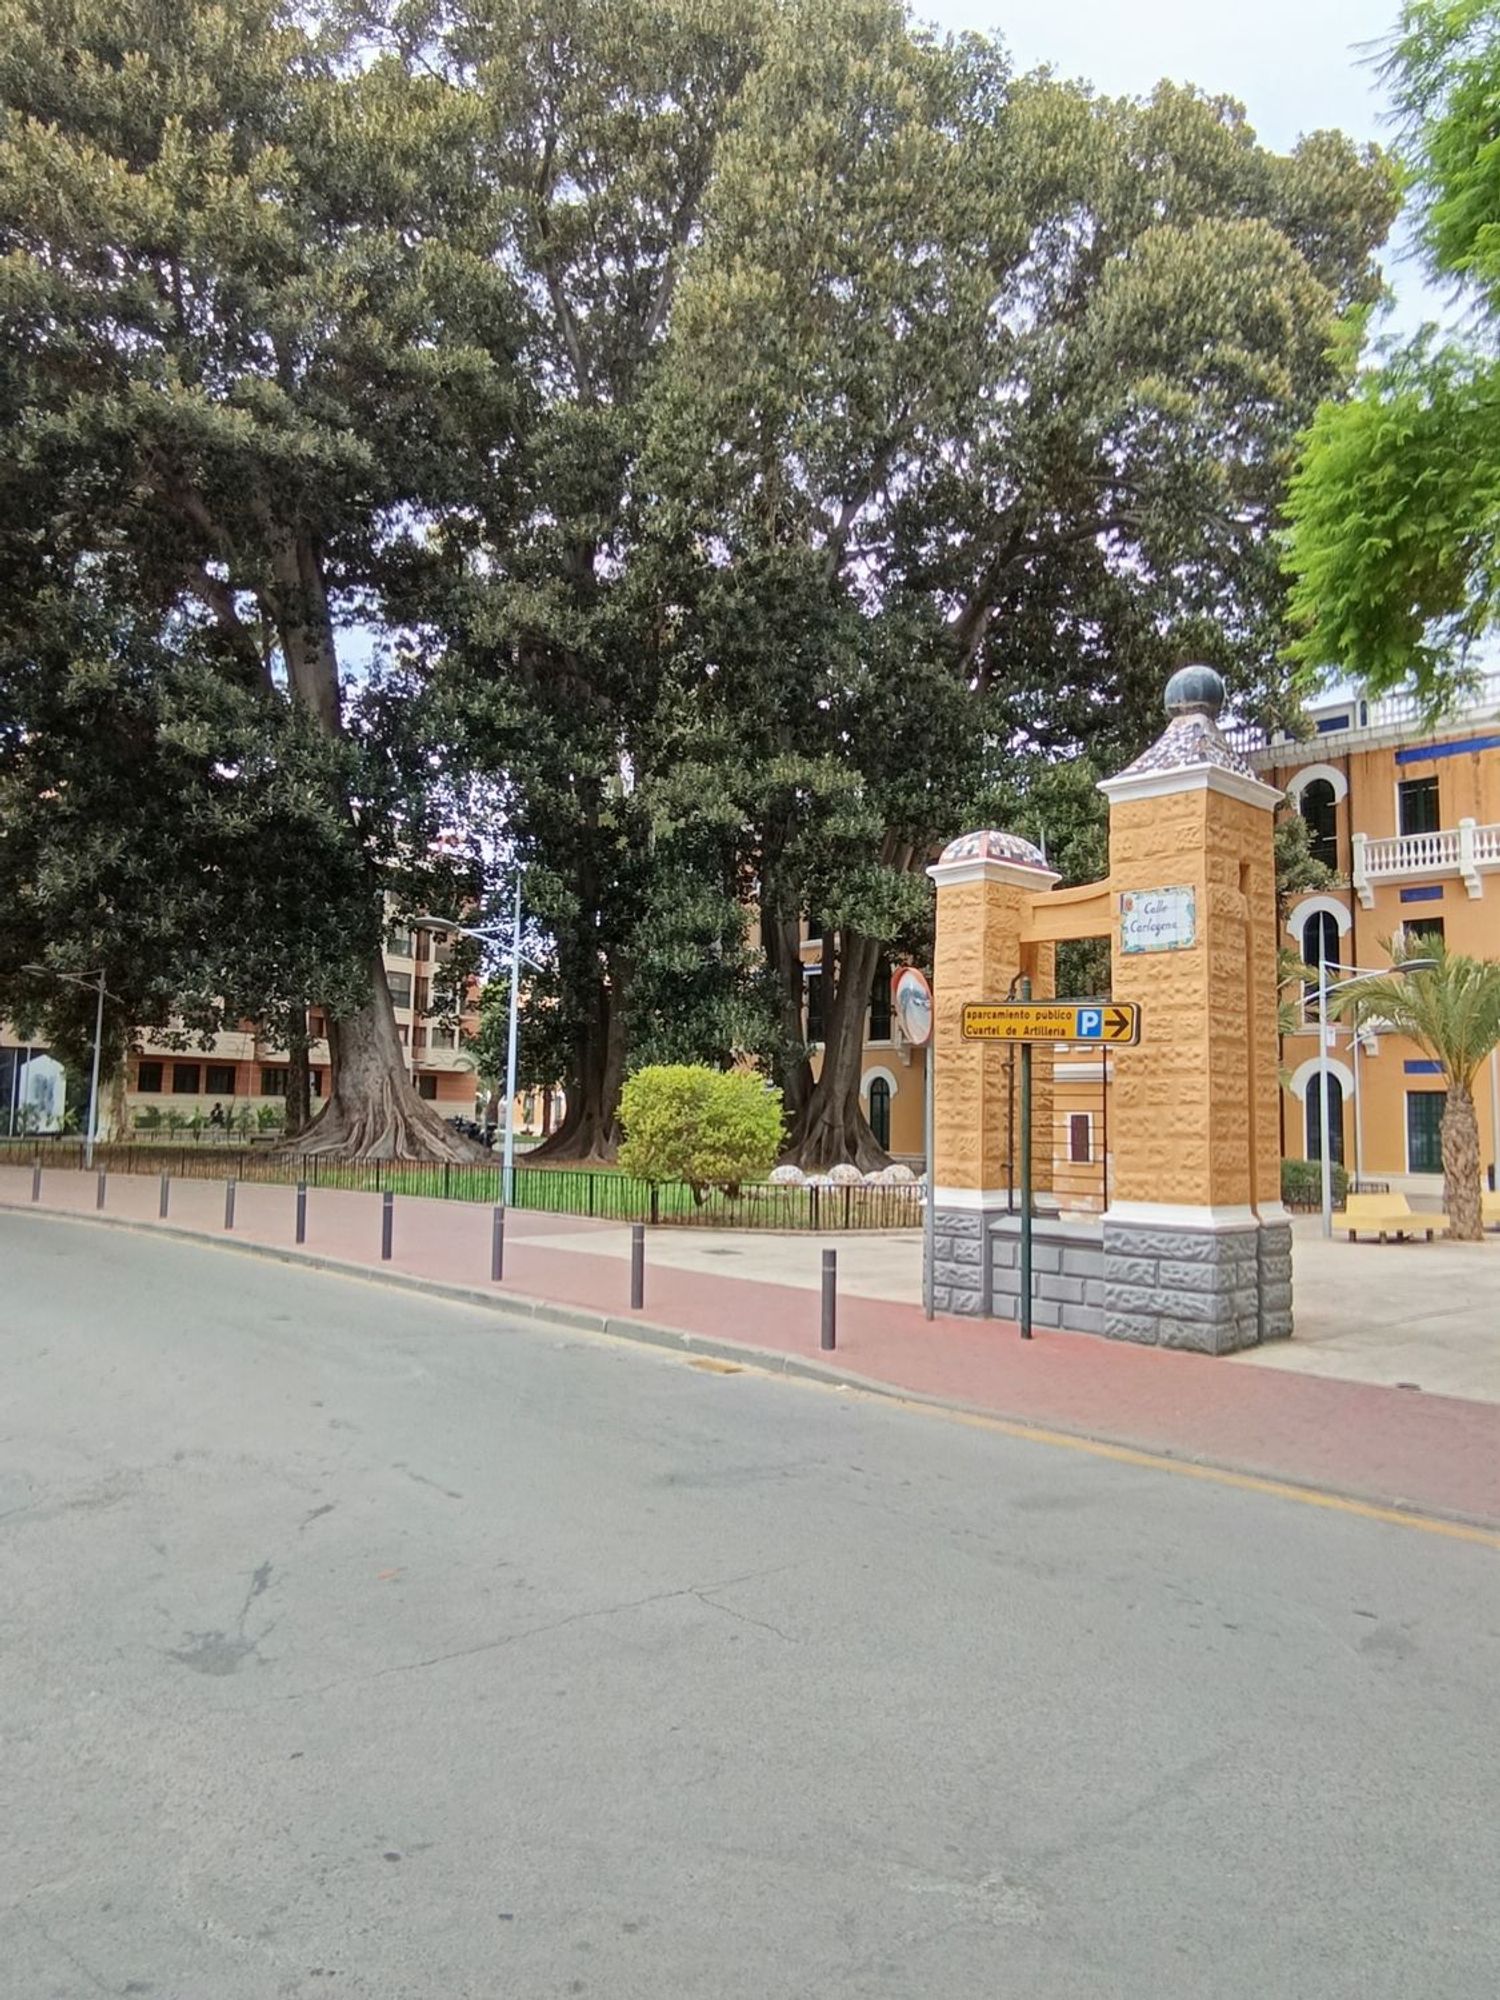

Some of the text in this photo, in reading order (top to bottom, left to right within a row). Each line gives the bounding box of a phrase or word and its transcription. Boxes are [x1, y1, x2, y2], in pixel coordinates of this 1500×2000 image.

[1143, 899, 1168, 915] Calle
[966, 1009, 1031, 1020] aparcamiento
[966, 1024, 1000, 1035] Cuartel
[1005, 1025, 1017, 1035] de
[1081, 1011, 1099, 1035] P
